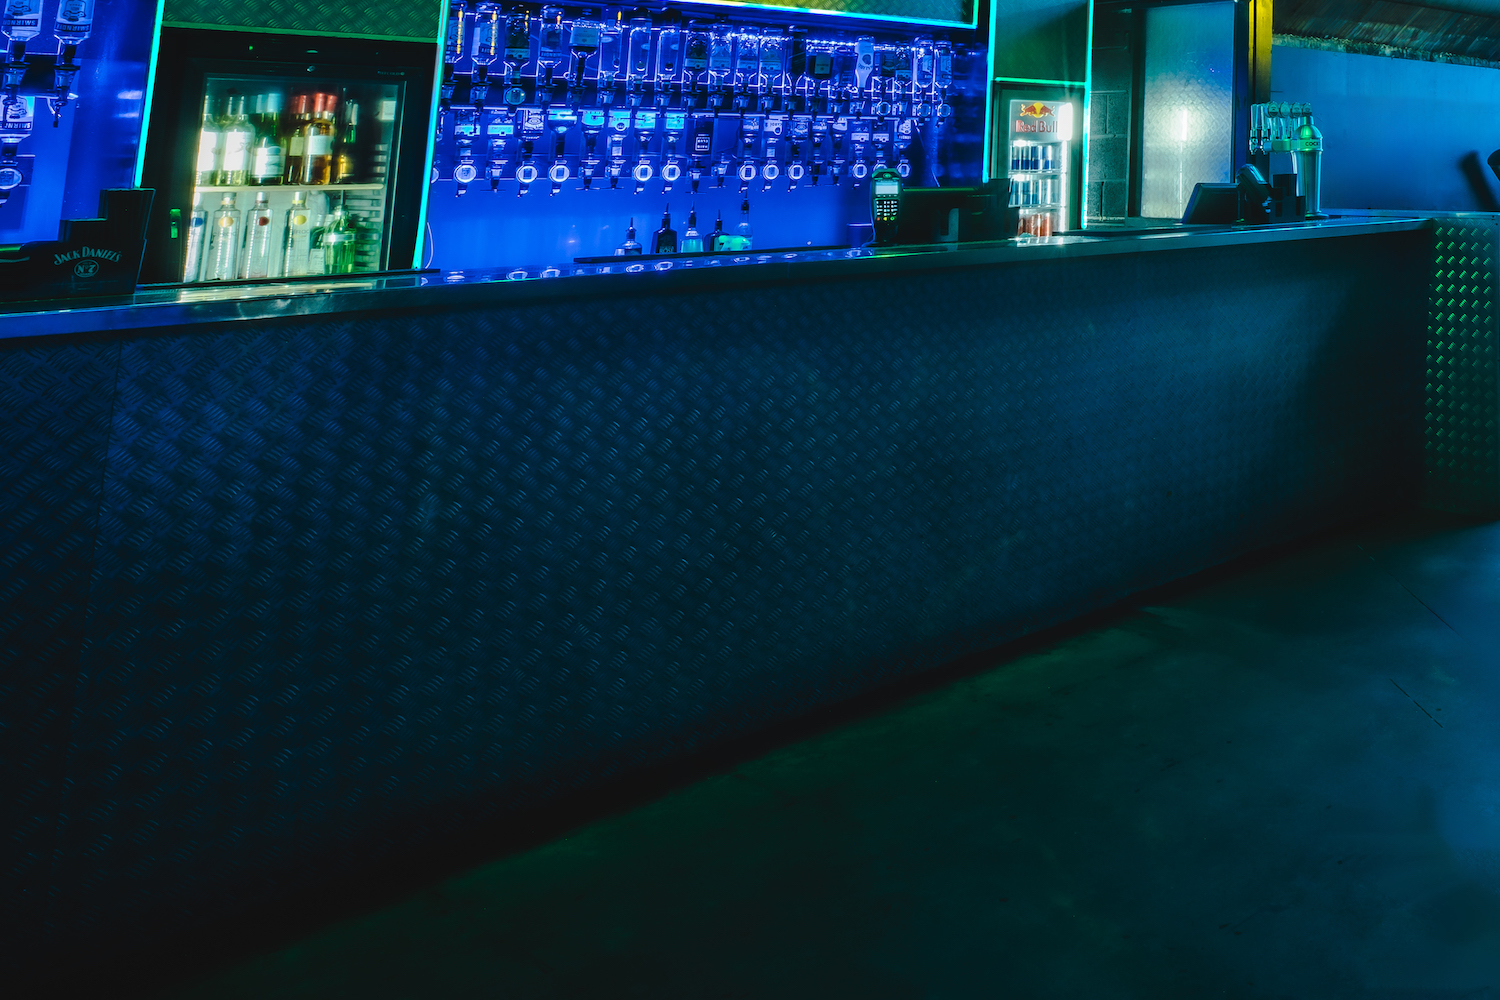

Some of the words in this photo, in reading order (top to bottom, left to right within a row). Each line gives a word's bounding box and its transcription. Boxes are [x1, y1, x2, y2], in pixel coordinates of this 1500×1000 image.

[1015, 119, 1037, 133] Red
[1038, 120, 1058, 133] Bull
[54, 250, 80, 265] JACK
